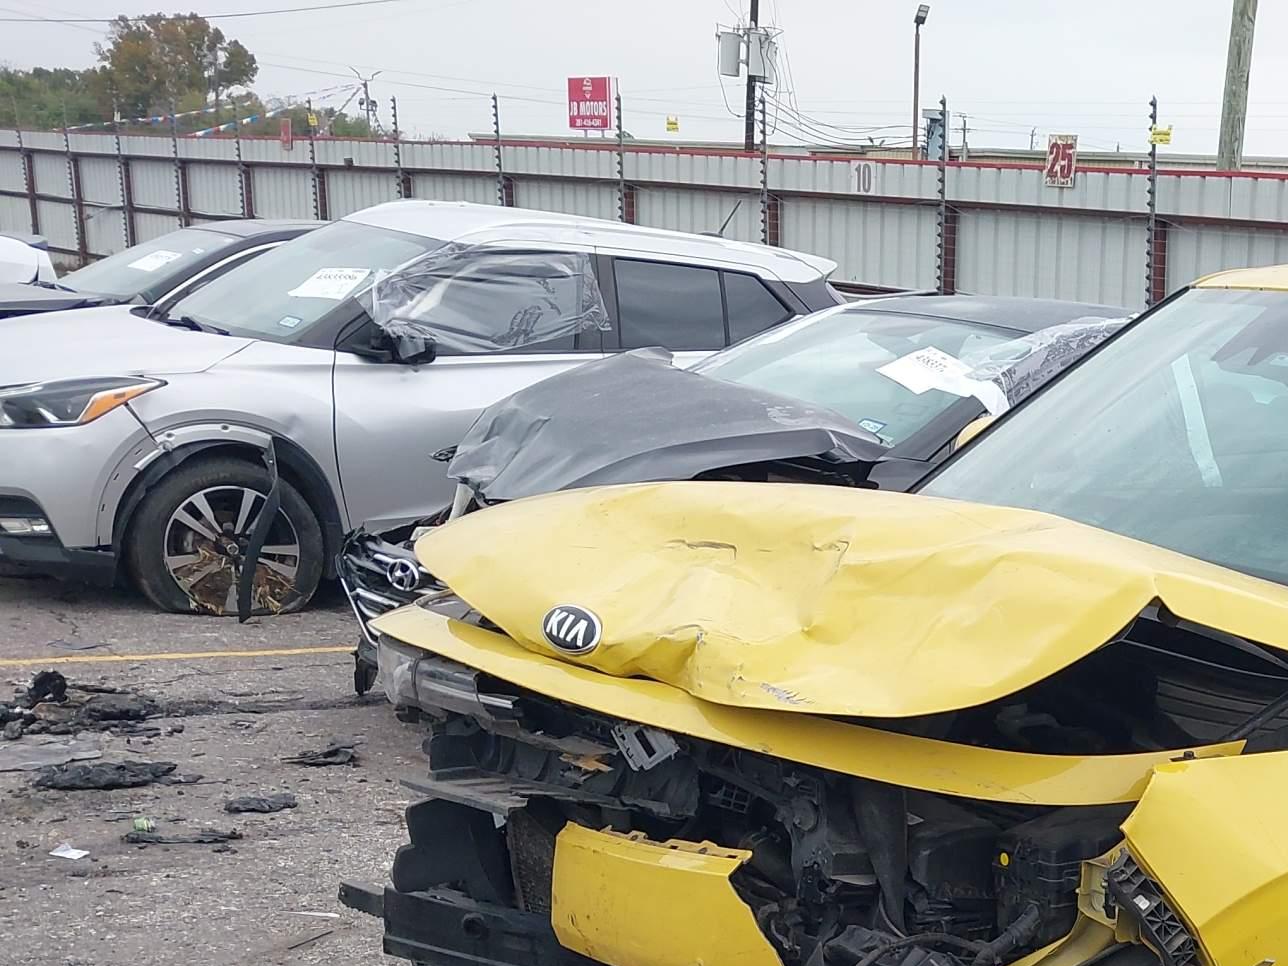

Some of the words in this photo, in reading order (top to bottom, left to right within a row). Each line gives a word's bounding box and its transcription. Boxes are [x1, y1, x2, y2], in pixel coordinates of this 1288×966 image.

[579, 101, 606, 116] MOTORS
[1047, 142, 1073, 178] 25
[855, 163, 872, 193] 10
[545, 608, 588, 647] KIA
